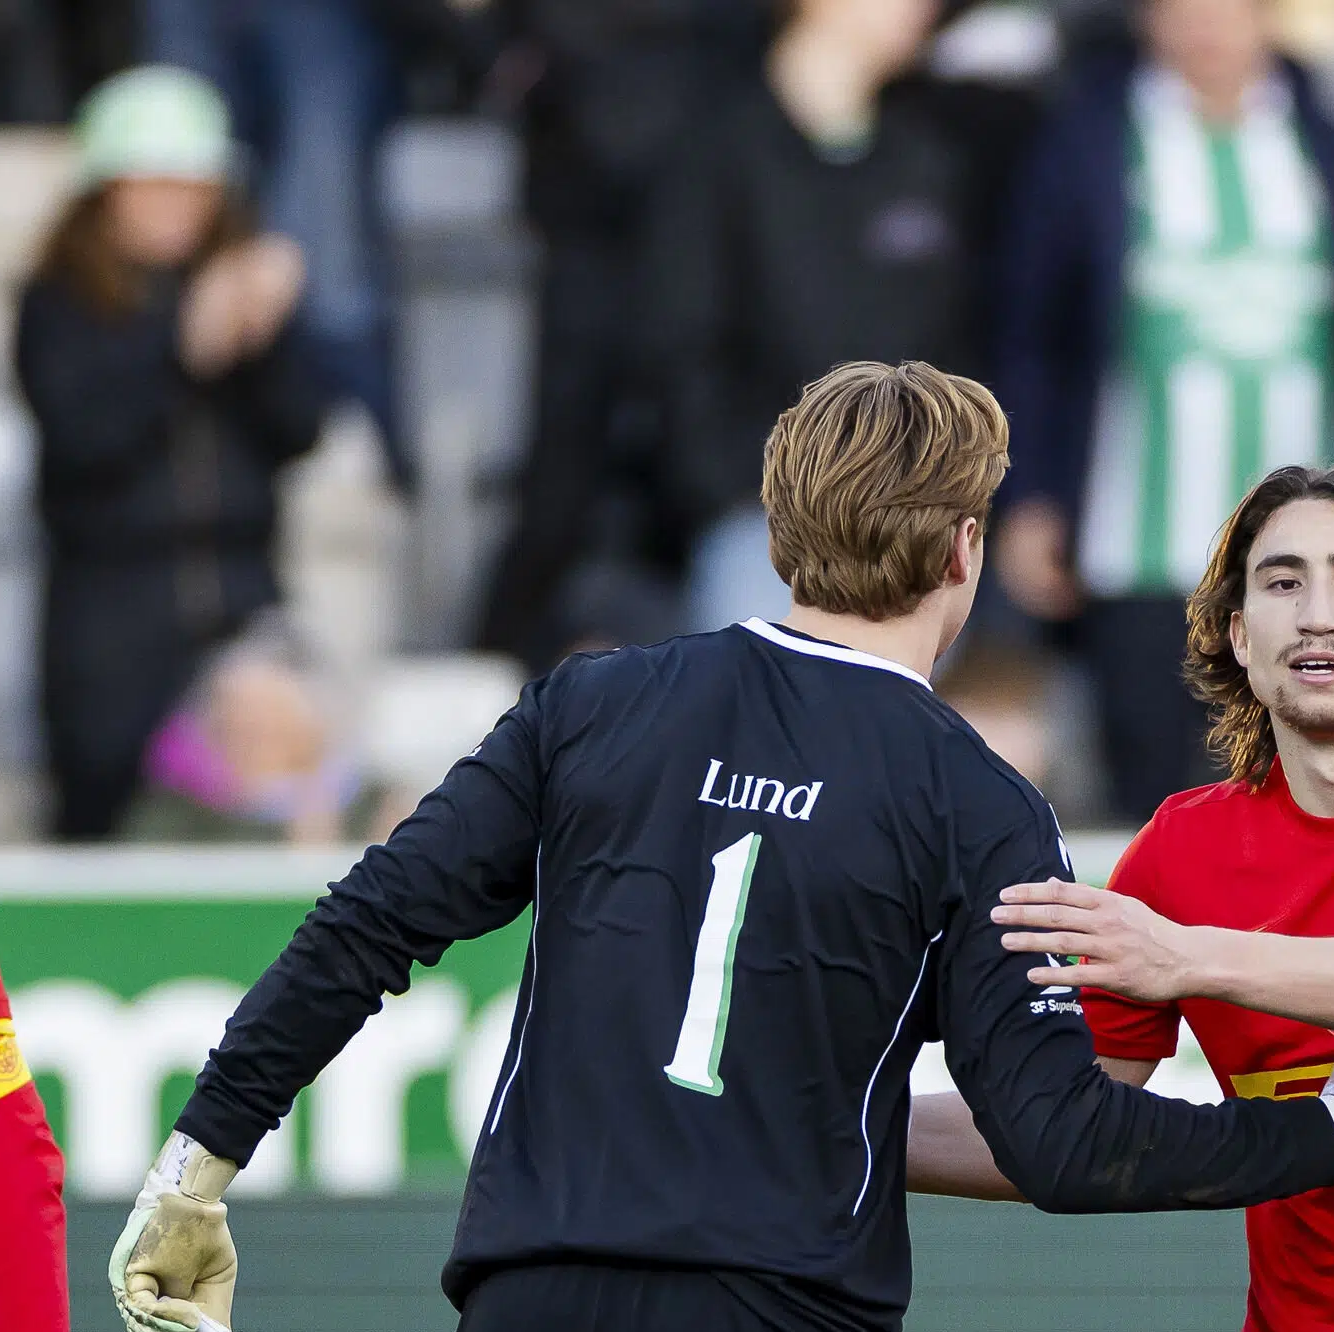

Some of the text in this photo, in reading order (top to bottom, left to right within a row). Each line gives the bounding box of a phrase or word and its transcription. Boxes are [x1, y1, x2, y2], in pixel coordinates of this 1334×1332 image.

[698, 758, 824, 821] Lund
[663, 831, 762, 1097] 1
[1029, 999, 1047, 1014] 3F
